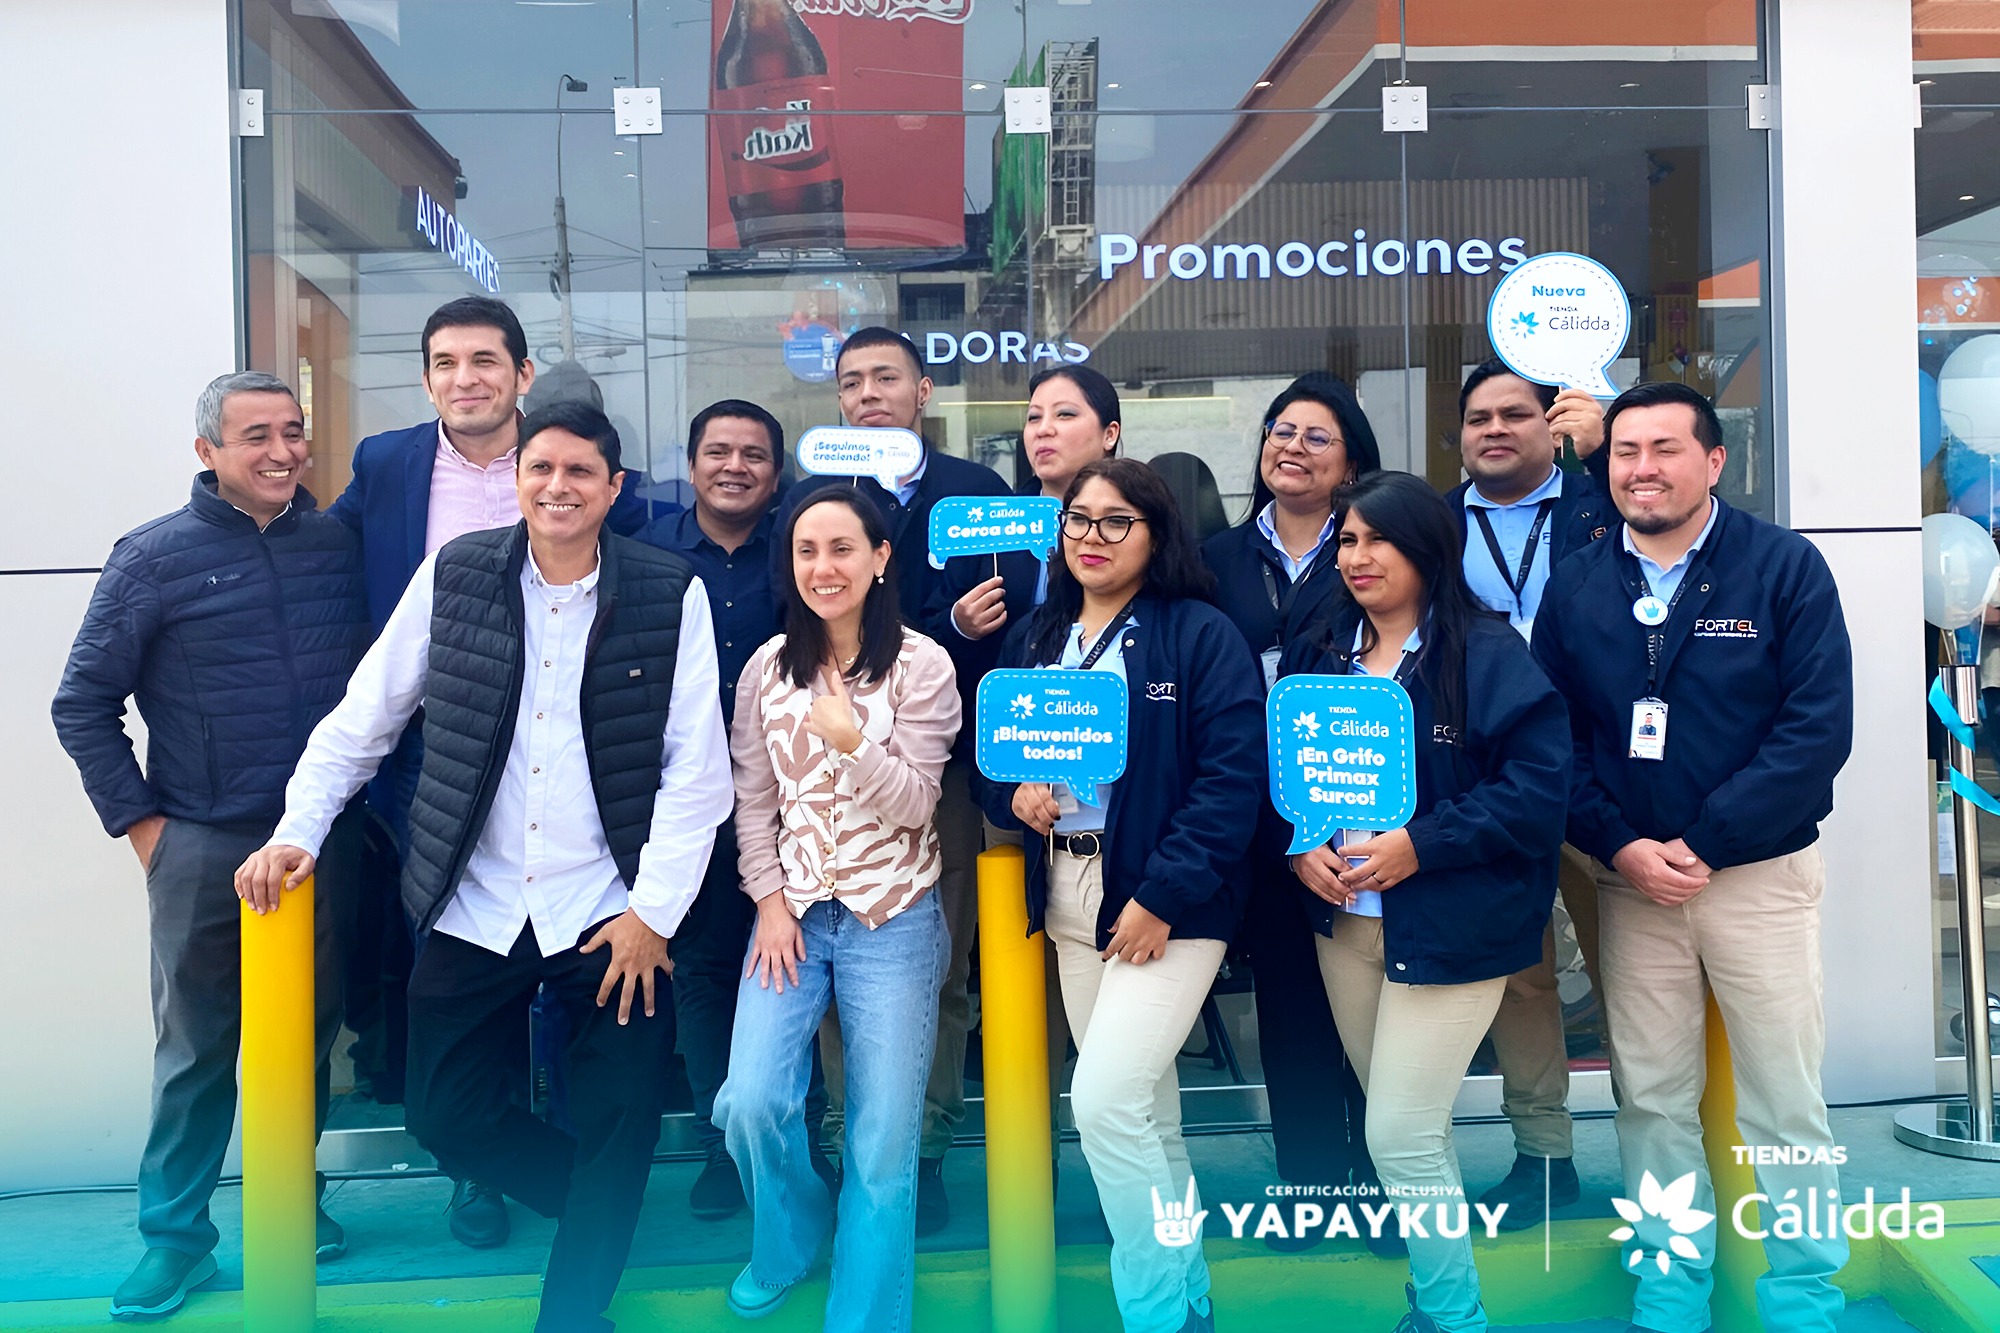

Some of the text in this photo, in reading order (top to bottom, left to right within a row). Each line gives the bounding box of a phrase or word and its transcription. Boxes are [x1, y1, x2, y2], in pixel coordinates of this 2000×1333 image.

[416, 185, 500, 293] AUTOPARTES
[1099, 228, 1528, 280] Promociones
[1531, 285, 1586, 297] Nueva
[1548, 316, 1610, 331] Cálidda
[901, 330, 1091, 365] DORAS
[947, 519, 1044, 538] Cerca de ti
[1694, 619, 1759, 633] FORTEL
[1043, 700, 1099, 716] Cálidda
[993, 725, 1114, 743] ¡Bienvenidos
[1329, 719, 1390, 738] Cálidda
[1022, 745, 1083, 760] todos!
[1296, 746, 1386, 766] ¡En Grifo
[1303, 765, 1380, 786] Primax
[1308, 786, 1376, 806] Surco!
